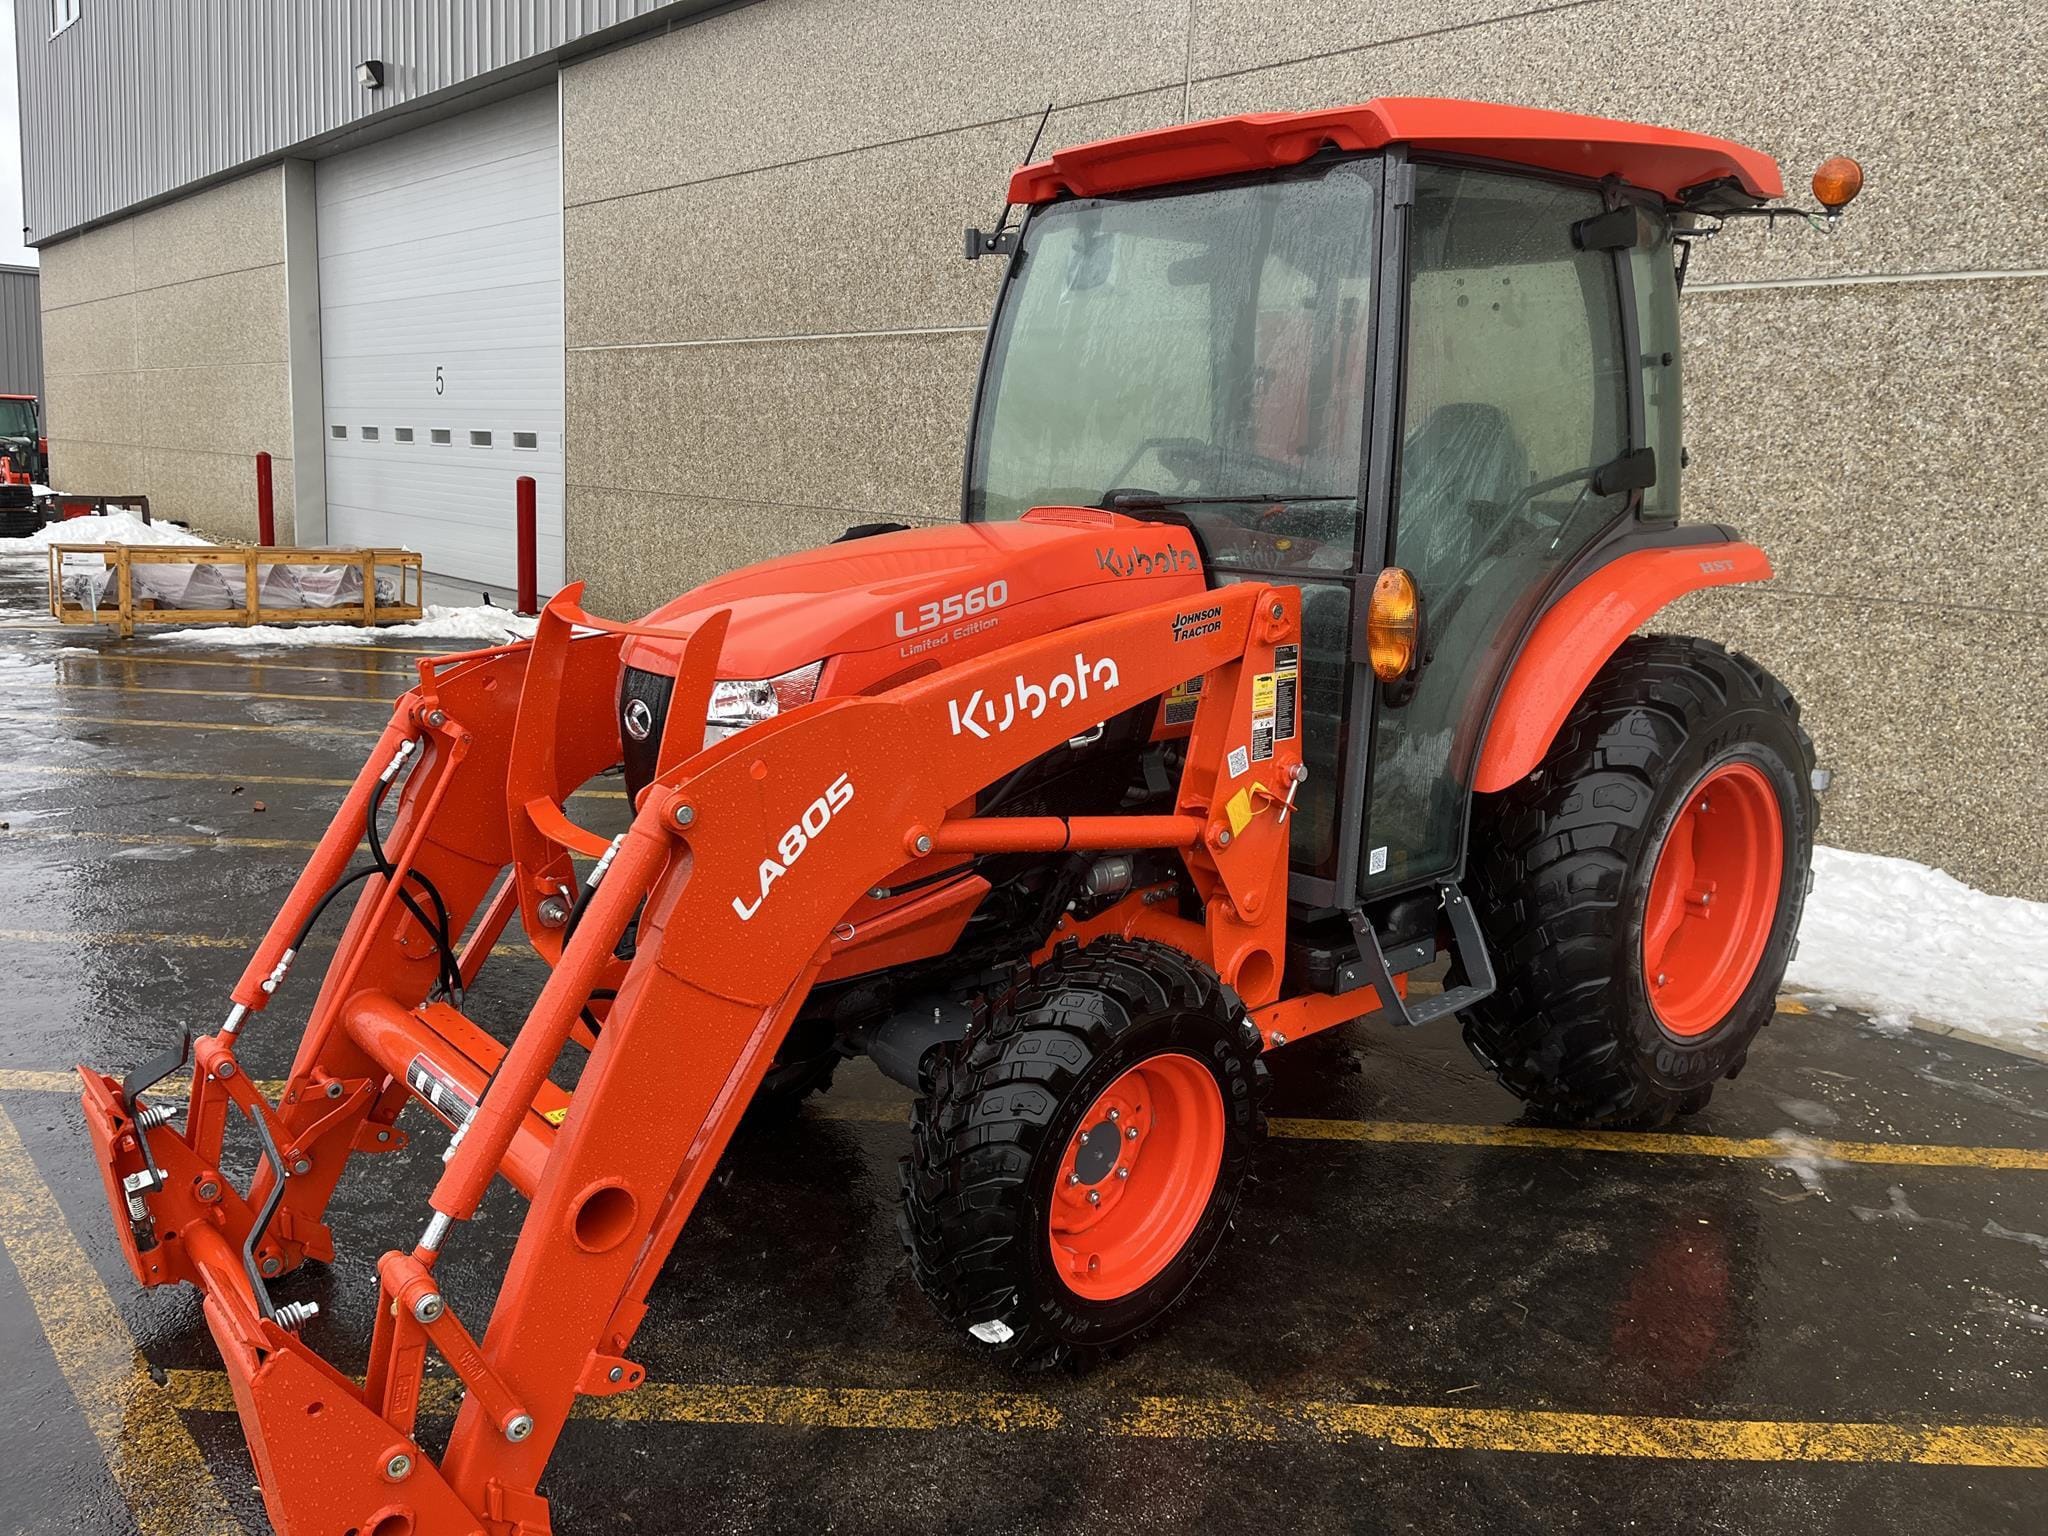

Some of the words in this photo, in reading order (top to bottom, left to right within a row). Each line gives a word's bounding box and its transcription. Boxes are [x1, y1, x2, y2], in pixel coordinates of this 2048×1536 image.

[435, 366, 444, 396] 5
[1095, 543, 1198, 577] Kubota
[895, 579, 1008, 638] L3560
[1171, 606, 1222, 629] JOHNSON
[900, 632, 949, 658] Limited
[952, 617, 999, 640] Edition
[1173, 620, 1222, 642] TRACTOR
[947, 652, 1120, 740] Kubota
[731, 771, 855, 921] LA805
